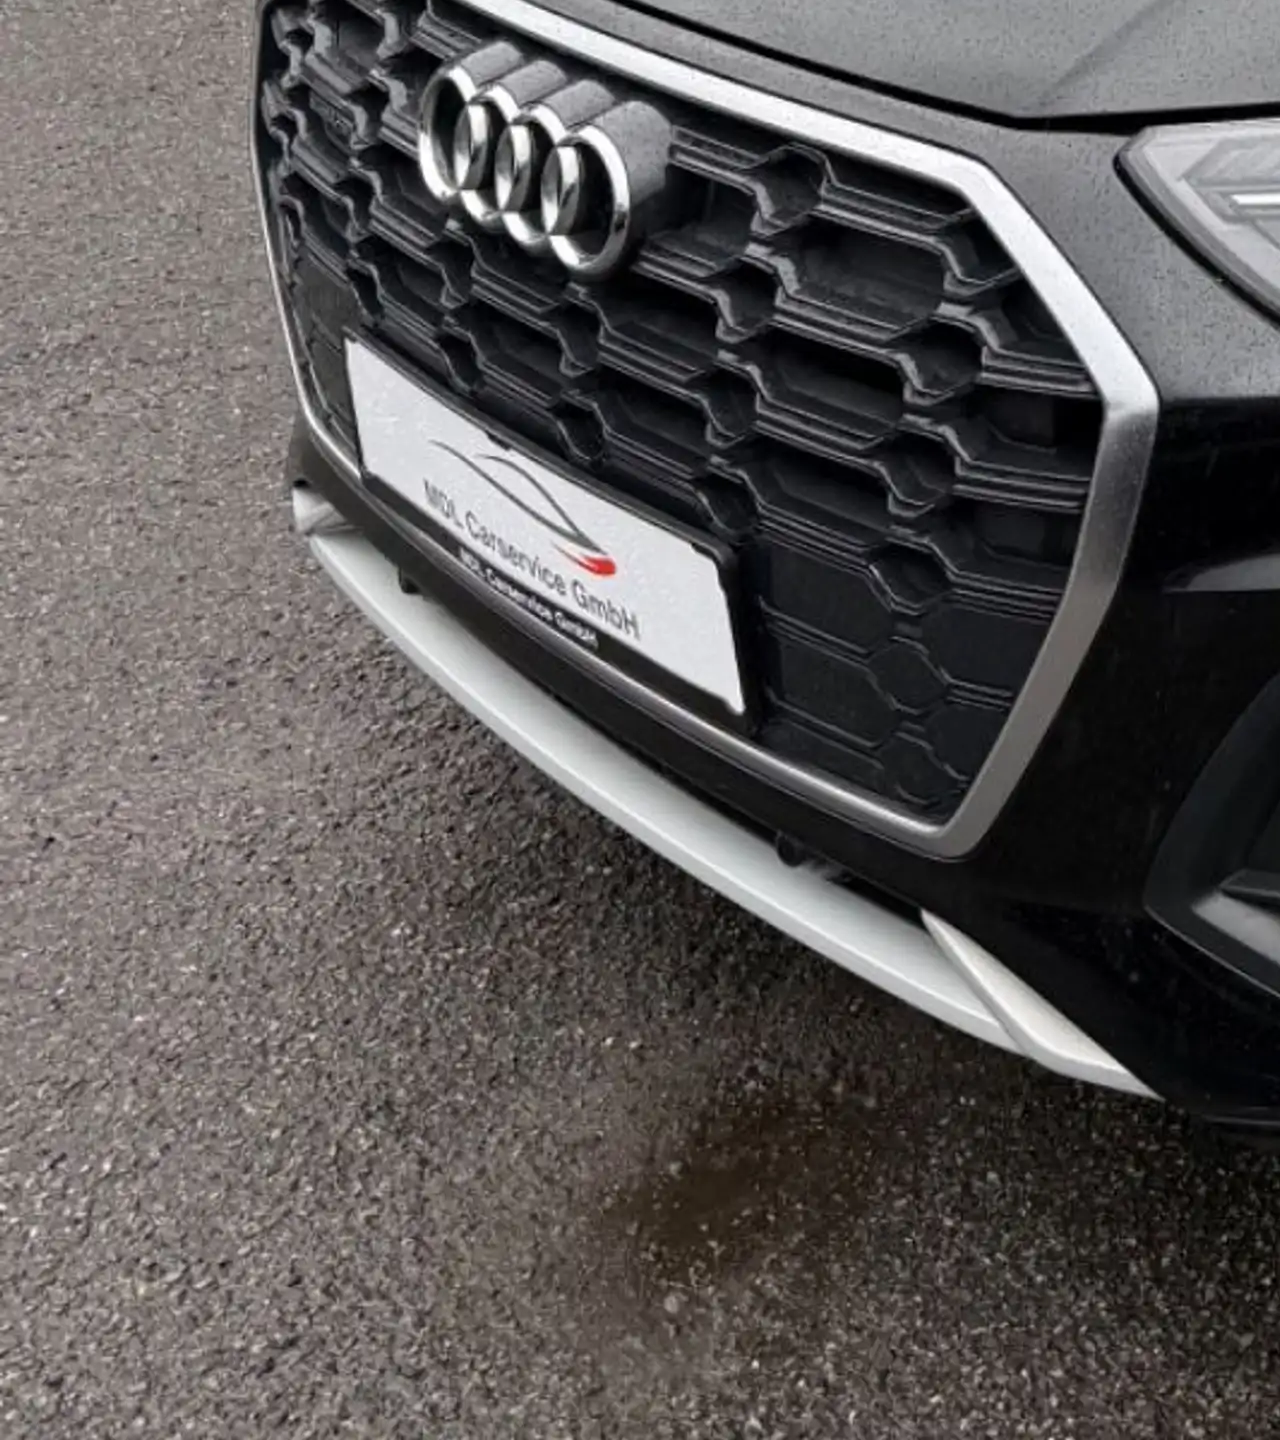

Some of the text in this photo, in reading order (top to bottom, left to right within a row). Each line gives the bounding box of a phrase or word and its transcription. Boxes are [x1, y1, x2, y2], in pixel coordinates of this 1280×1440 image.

[423, 478, 642, 641] MDL Carservice GmbH
